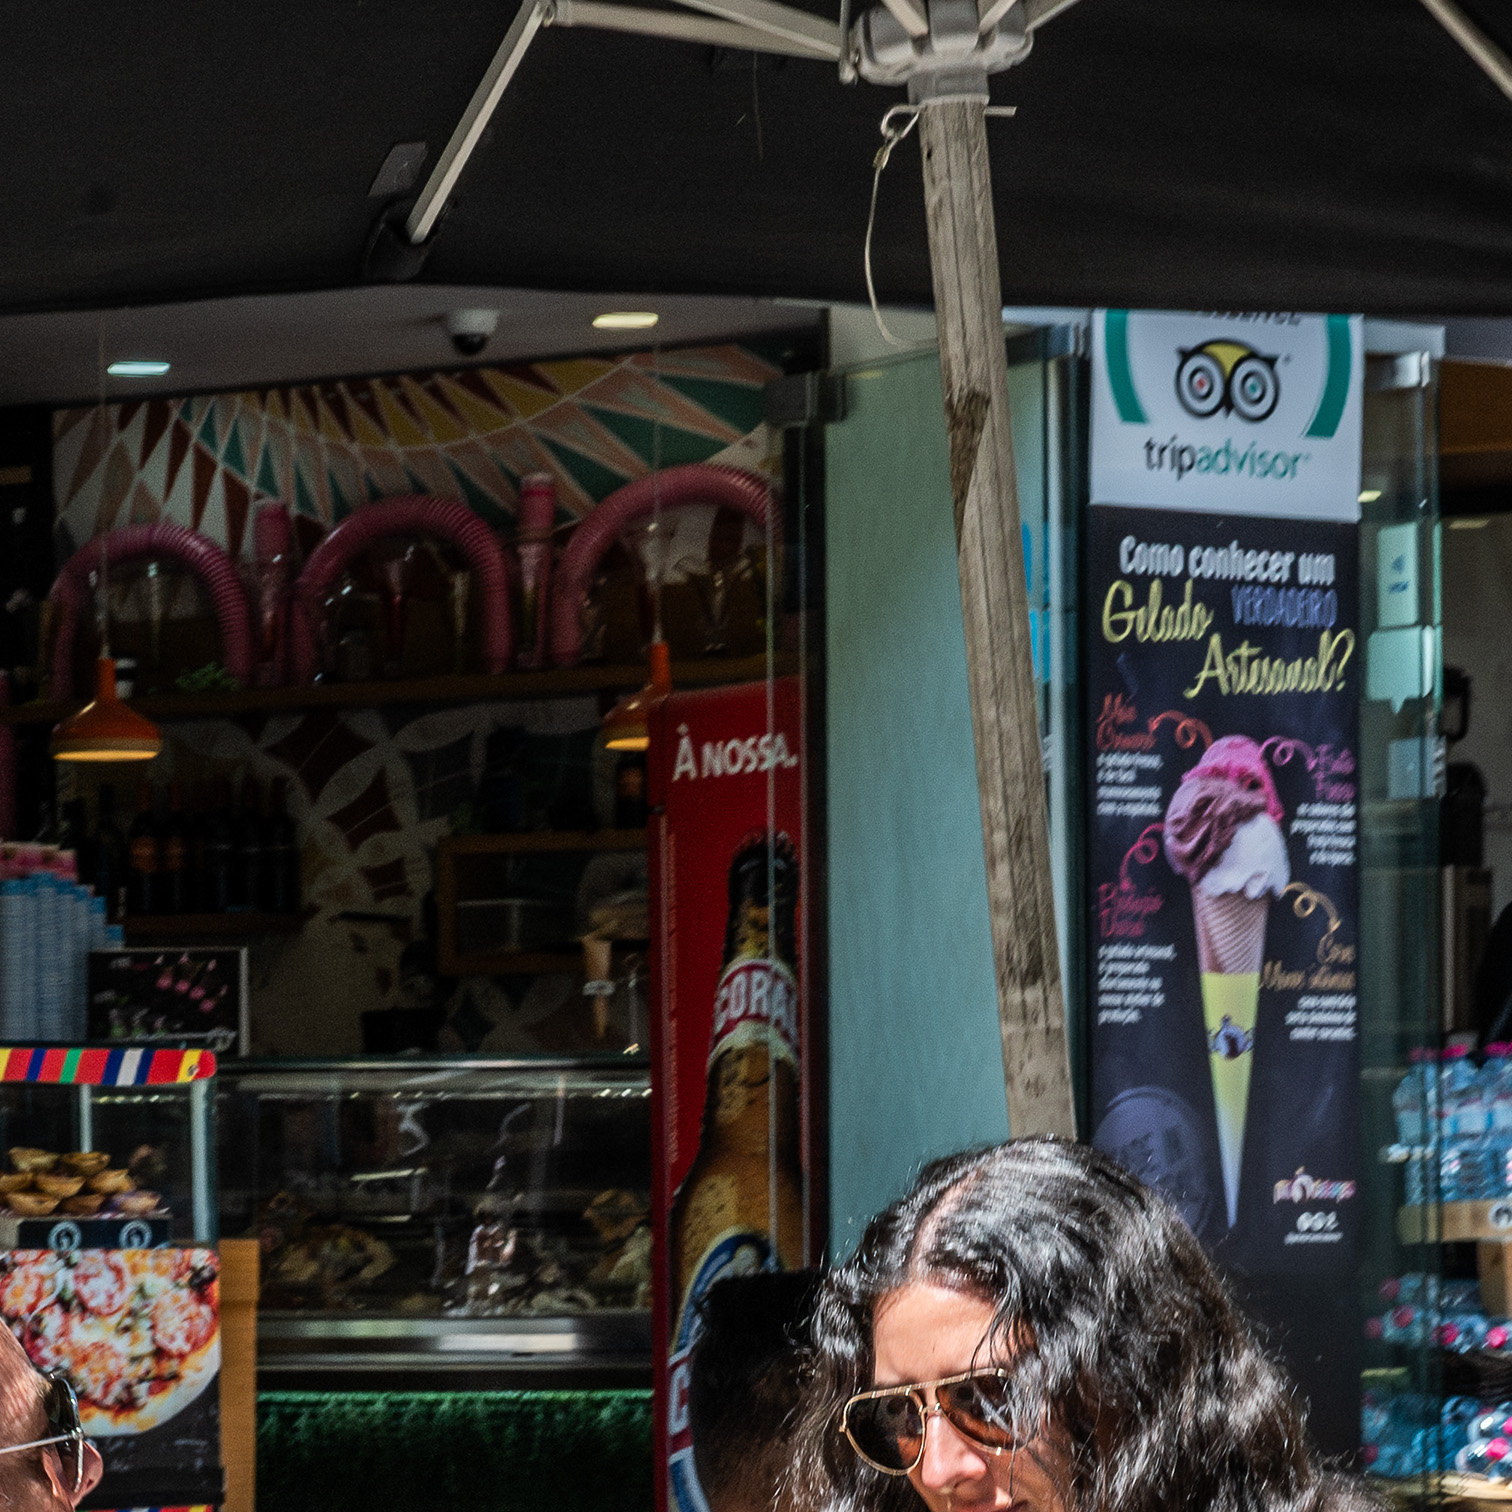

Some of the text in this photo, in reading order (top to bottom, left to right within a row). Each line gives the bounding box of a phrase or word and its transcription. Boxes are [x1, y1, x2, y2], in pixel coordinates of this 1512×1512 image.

[1144, 435, 1302, 481] tripadvisor
[1119, 535, 1336, 586] Como conhecer um
[1102, 577, 1215, 643] Gelado
[1182, 628, 1356, 698] Artesanal?
